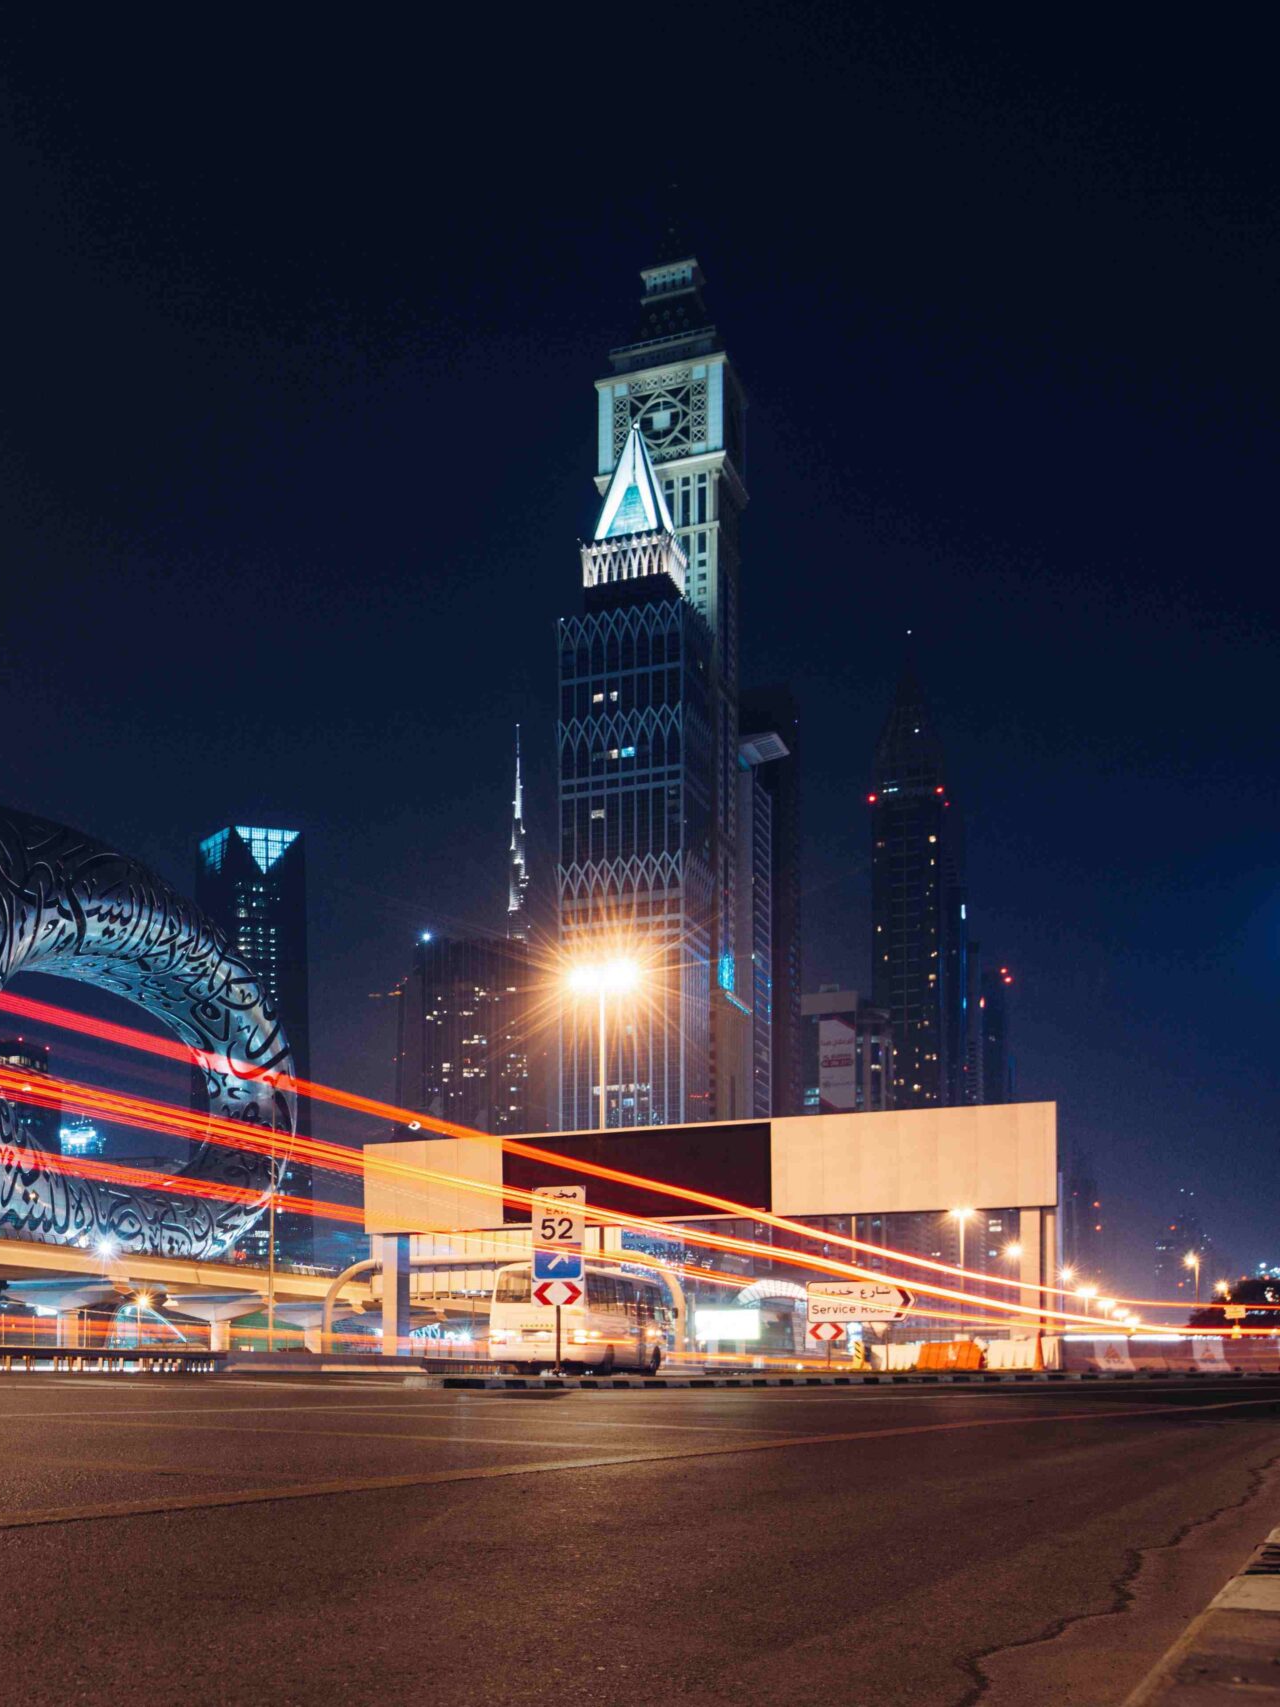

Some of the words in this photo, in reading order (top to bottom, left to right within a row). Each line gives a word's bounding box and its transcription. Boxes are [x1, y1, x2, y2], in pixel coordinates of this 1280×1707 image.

[541, 1189, 577, 1202] مخ
[545, 1205, 570, 1215] EX
[540, 1217, 574, 1241] 52
[815, 1286, 854, 1297] خدما
[859, 1285, 891, 1299] شارع
[811, 1304, 856, 1315] Service
[861, 1304, 892, 1314] Roa
